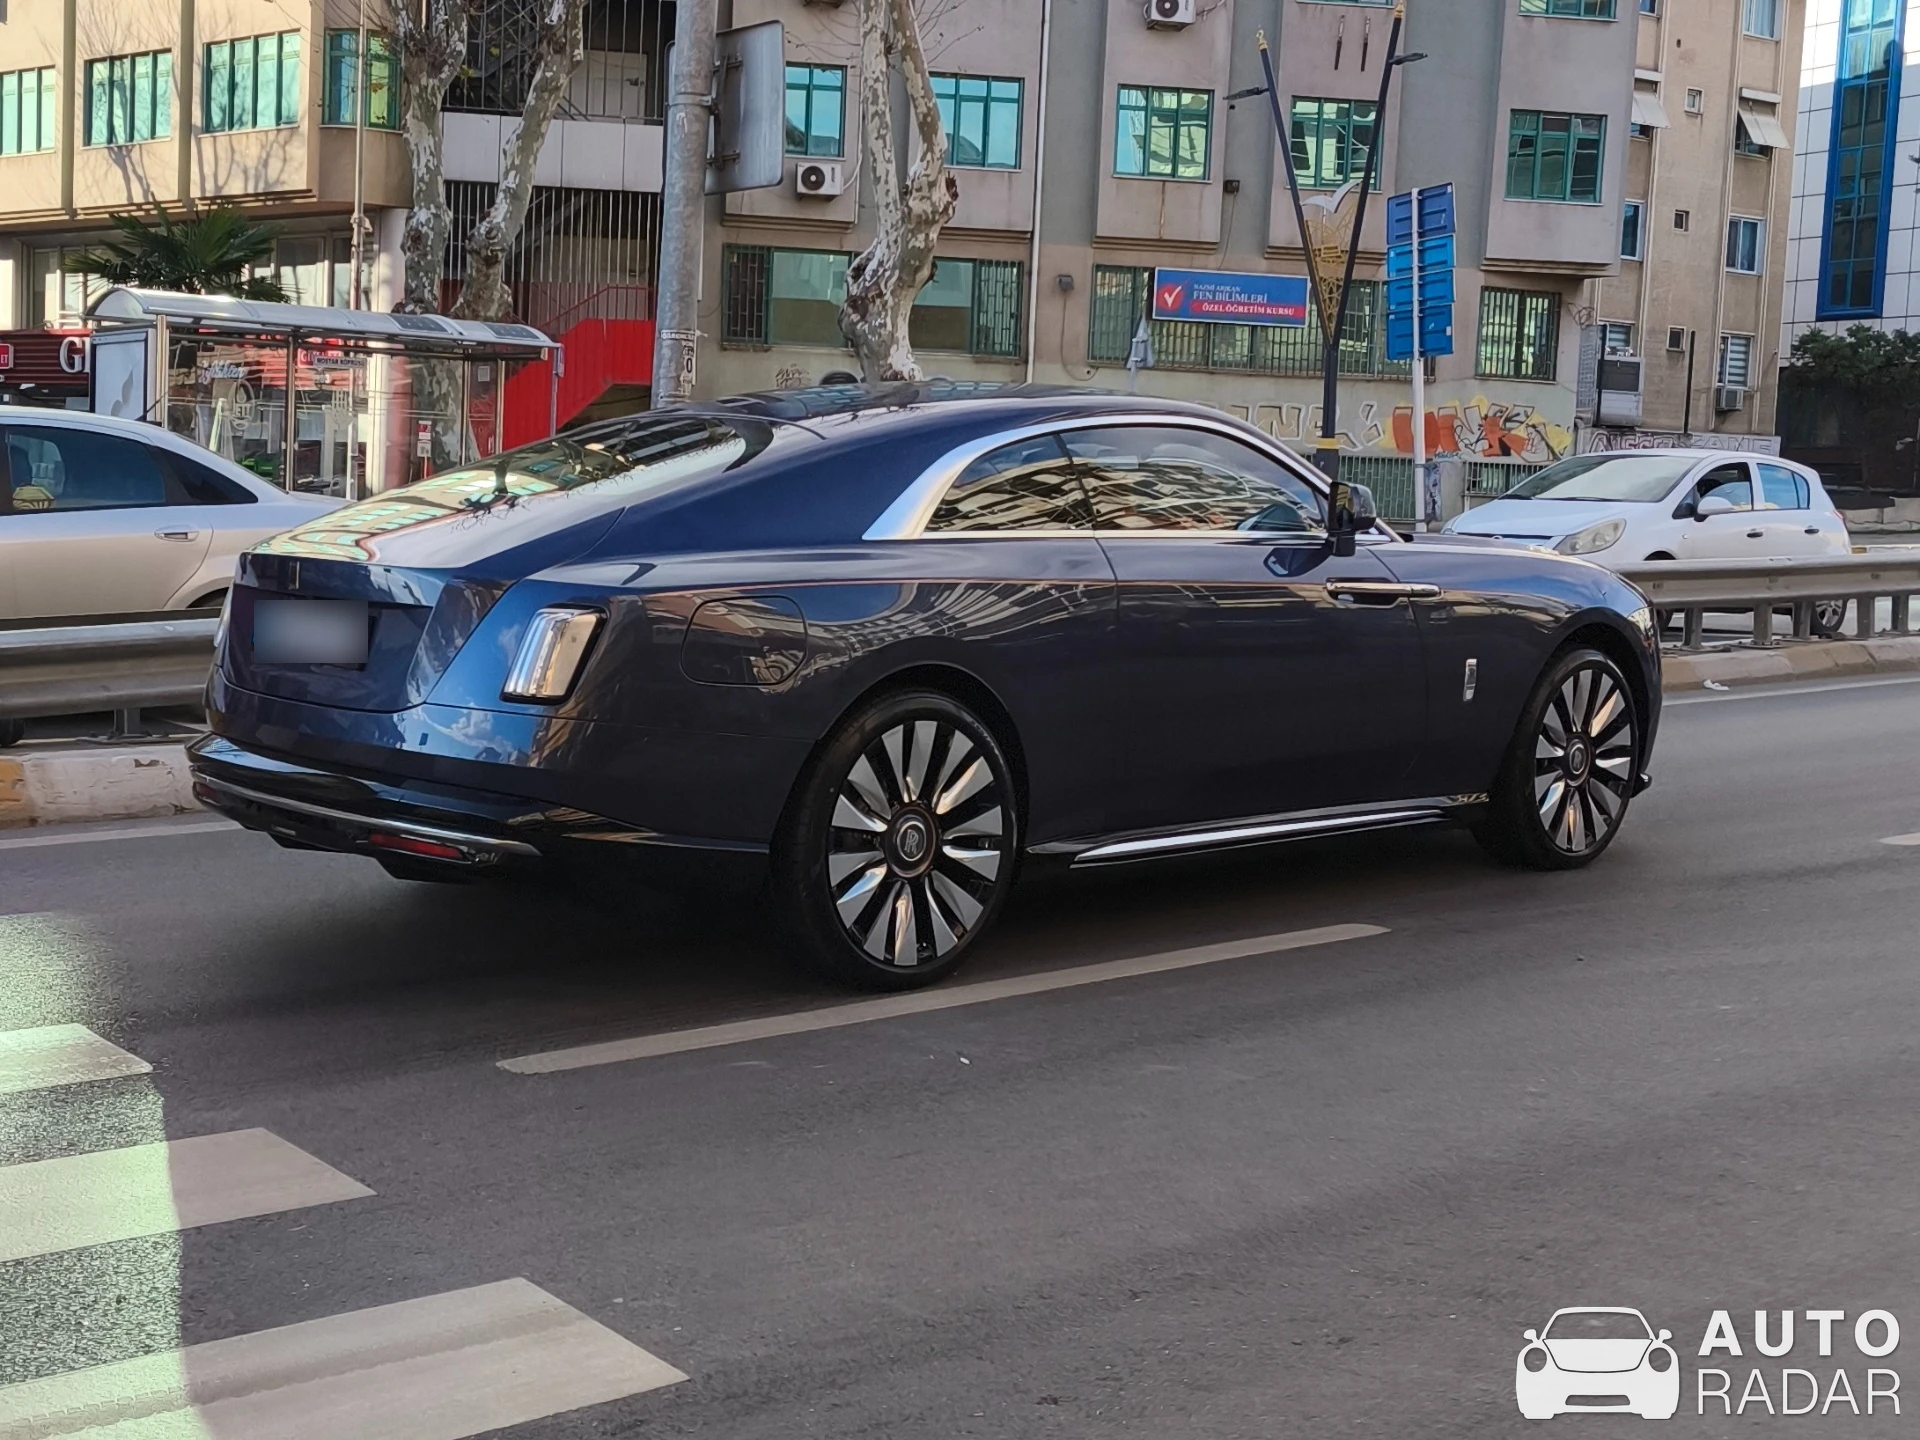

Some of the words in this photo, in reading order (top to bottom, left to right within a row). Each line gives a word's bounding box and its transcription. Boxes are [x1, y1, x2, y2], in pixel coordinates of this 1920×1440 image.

[1193, 291, 1213, 300] FEN
[1215, 292, 1268, 304] BİLİMLERİ
[1202, 304, 1225, 312] ÖZEL
[1225, 304, 1265, 314] ÖĞRETİM
[1266, 307, 1295, 316] KURSU
